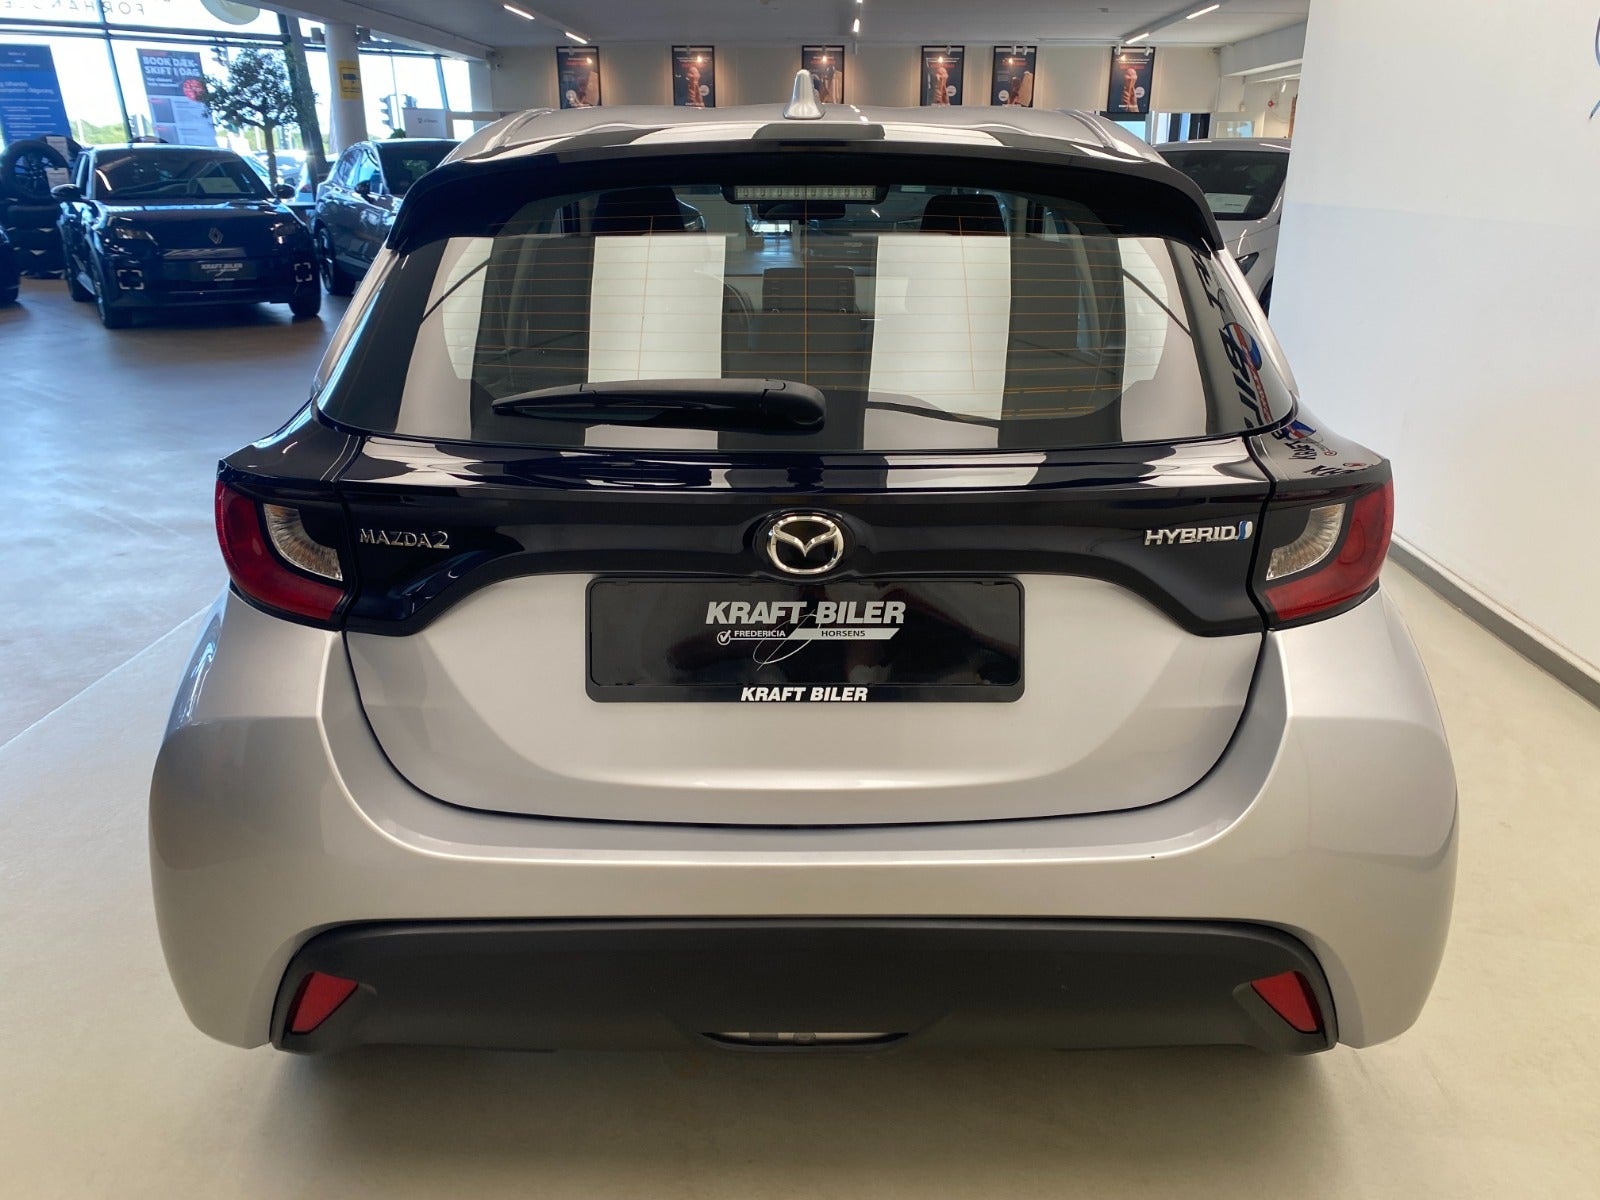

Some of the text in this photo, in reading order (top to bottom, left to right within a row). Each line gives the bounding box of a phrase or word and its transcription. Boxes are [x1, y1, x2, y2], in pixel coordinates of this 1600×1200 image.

[142, 56, 198, 68] BOOK DÆK-
[144, 65, 171, 76] SKIFT
[179, 67, 201, 77] DAG
[359, 528, 450, 549] MAZDA2
[1144, 525, 1238, 546] HYBRID
[705, 601, 907, 625] KRAFT BILER
[734, 630, 786, 638] FREDERICIA
[740, 687, 869, 702] KRAFT BILER
